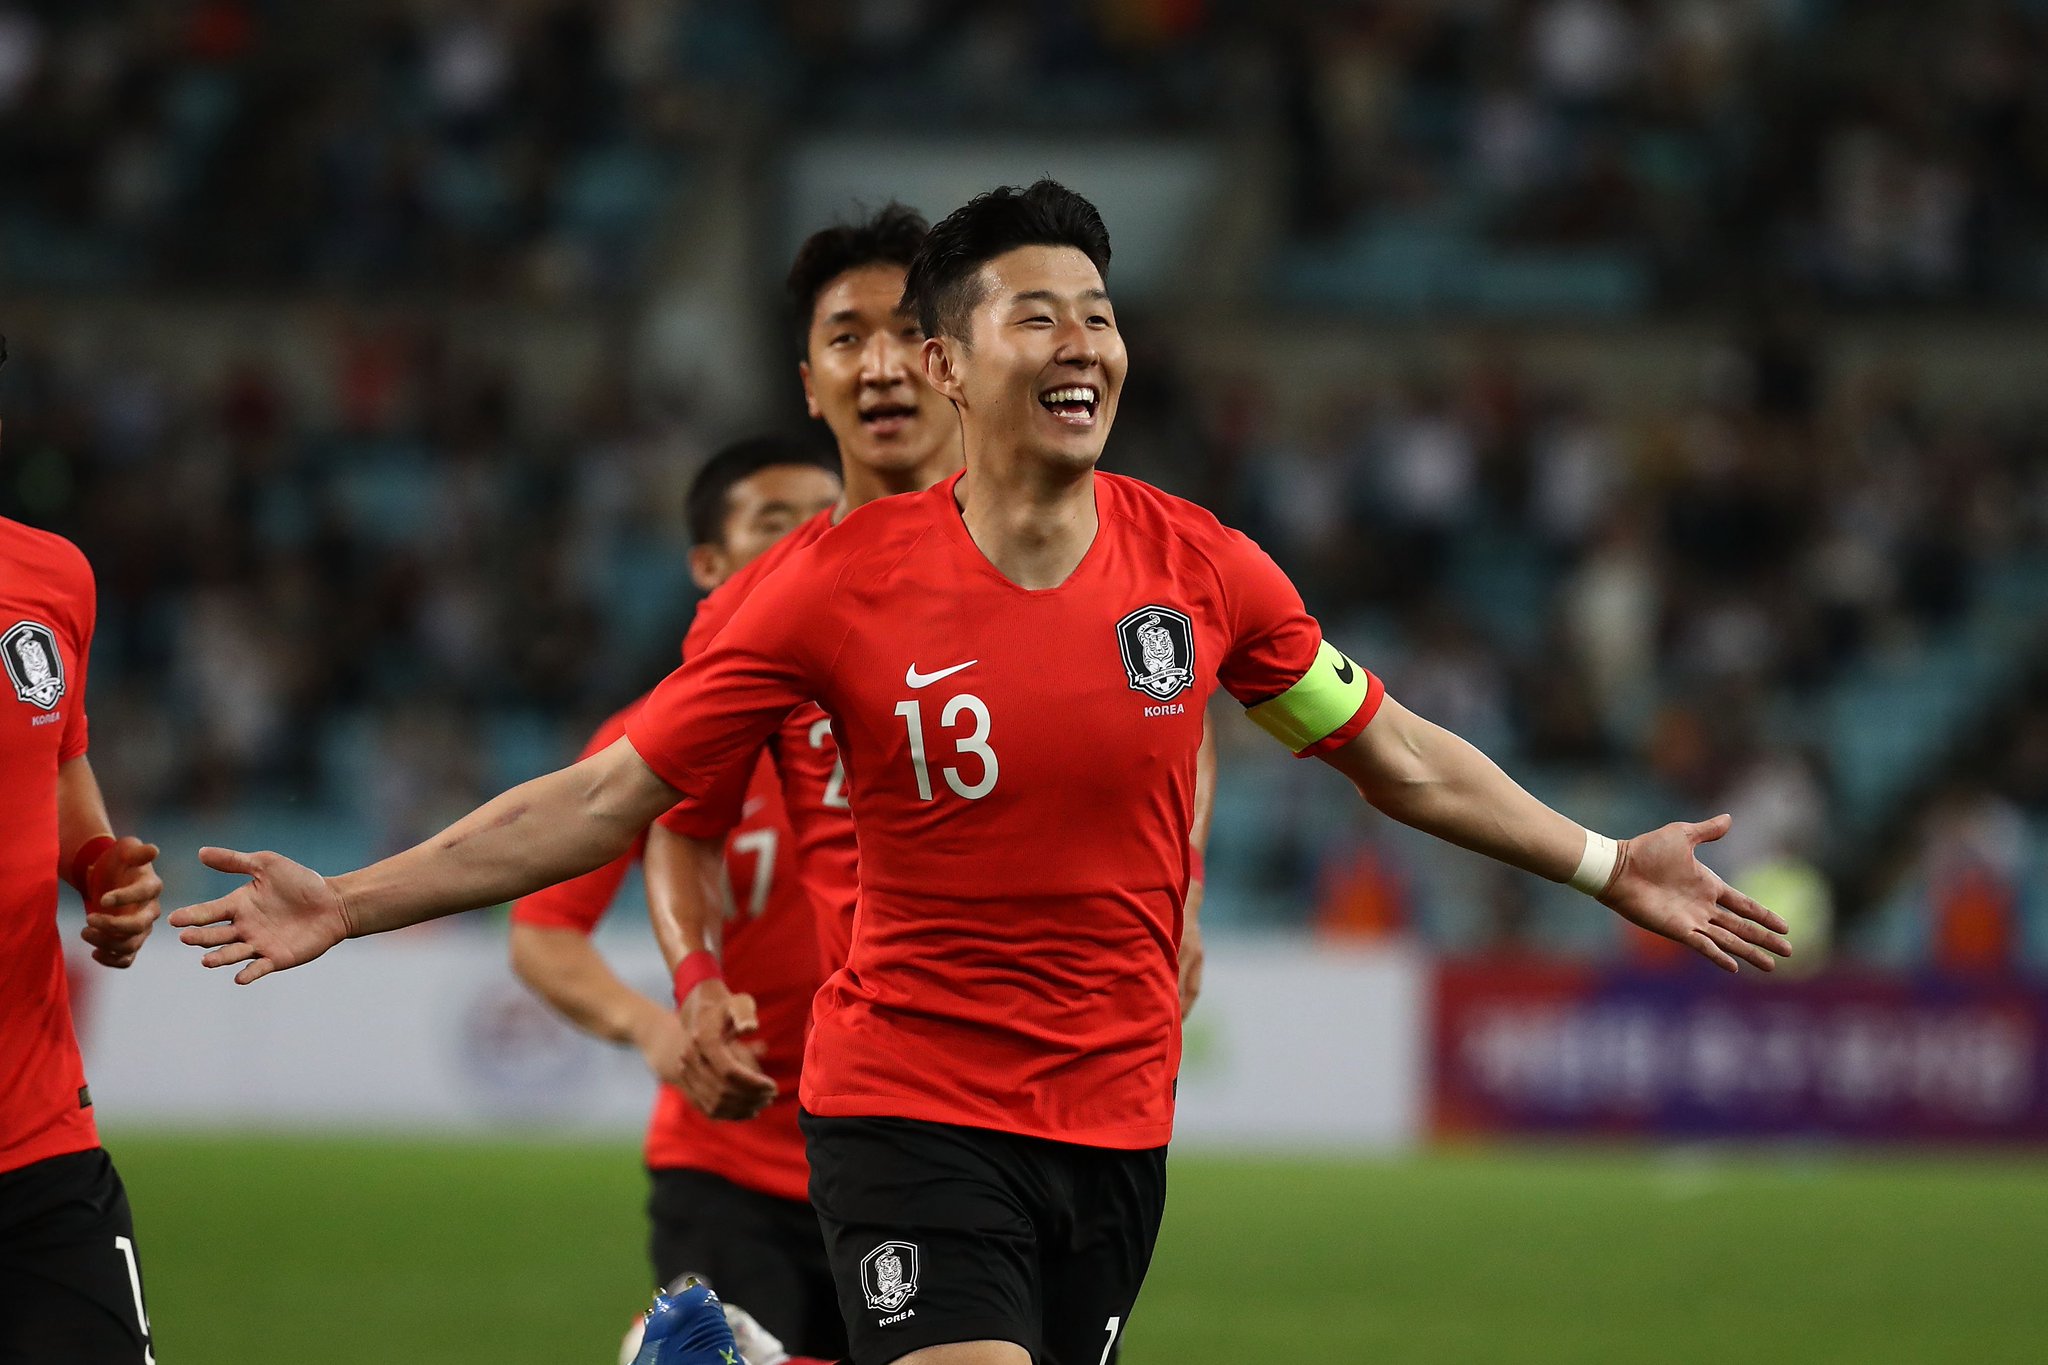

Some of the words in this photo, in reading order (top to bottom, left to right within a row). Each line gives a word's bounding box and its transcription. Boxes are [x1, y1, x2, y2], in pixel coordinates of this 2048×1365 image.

[1144, 703, 1185, 717] KOREA
[31, 711, 61, 727] KOREA
[894, 693, 999, 801] 13
[878, 1309, 916, 1328] KOREA
